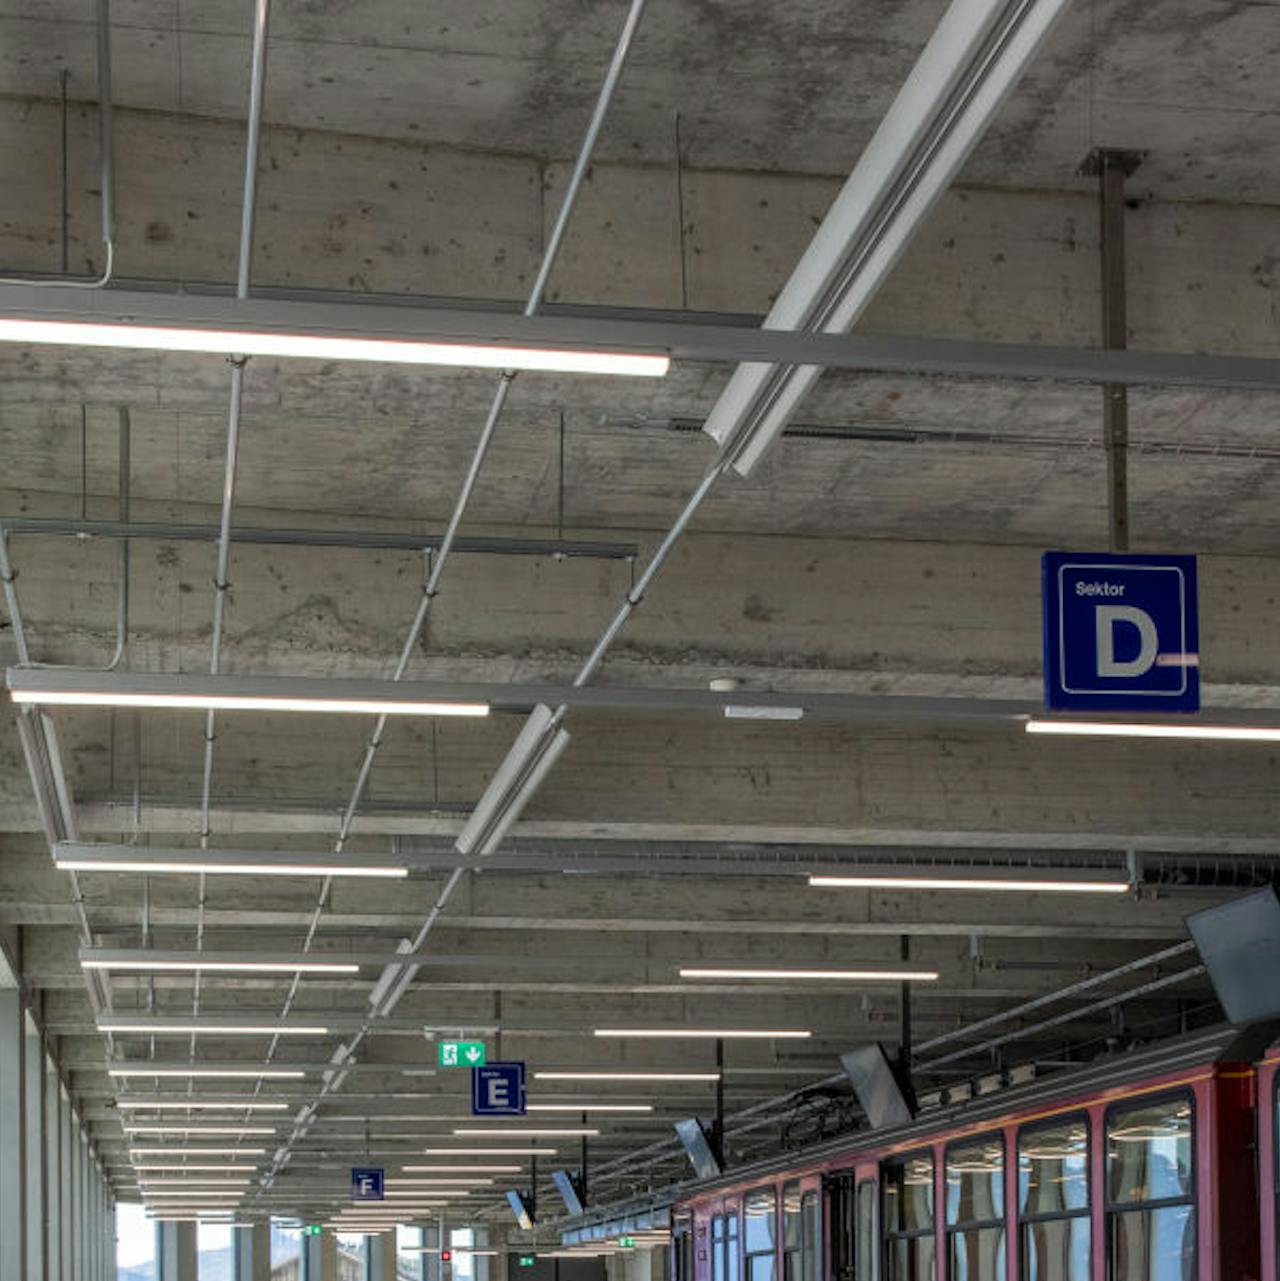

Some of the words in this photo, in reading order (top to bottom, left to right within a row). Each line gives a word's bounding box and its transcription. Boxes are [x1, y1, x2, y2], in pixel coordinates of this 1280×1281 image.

[1075, 581, 1125, 596] Sektor
[1095, 604, 1159, 677] D
[488, 1079, 509, 1106] E
[361, 1179, 374, 1195] F
